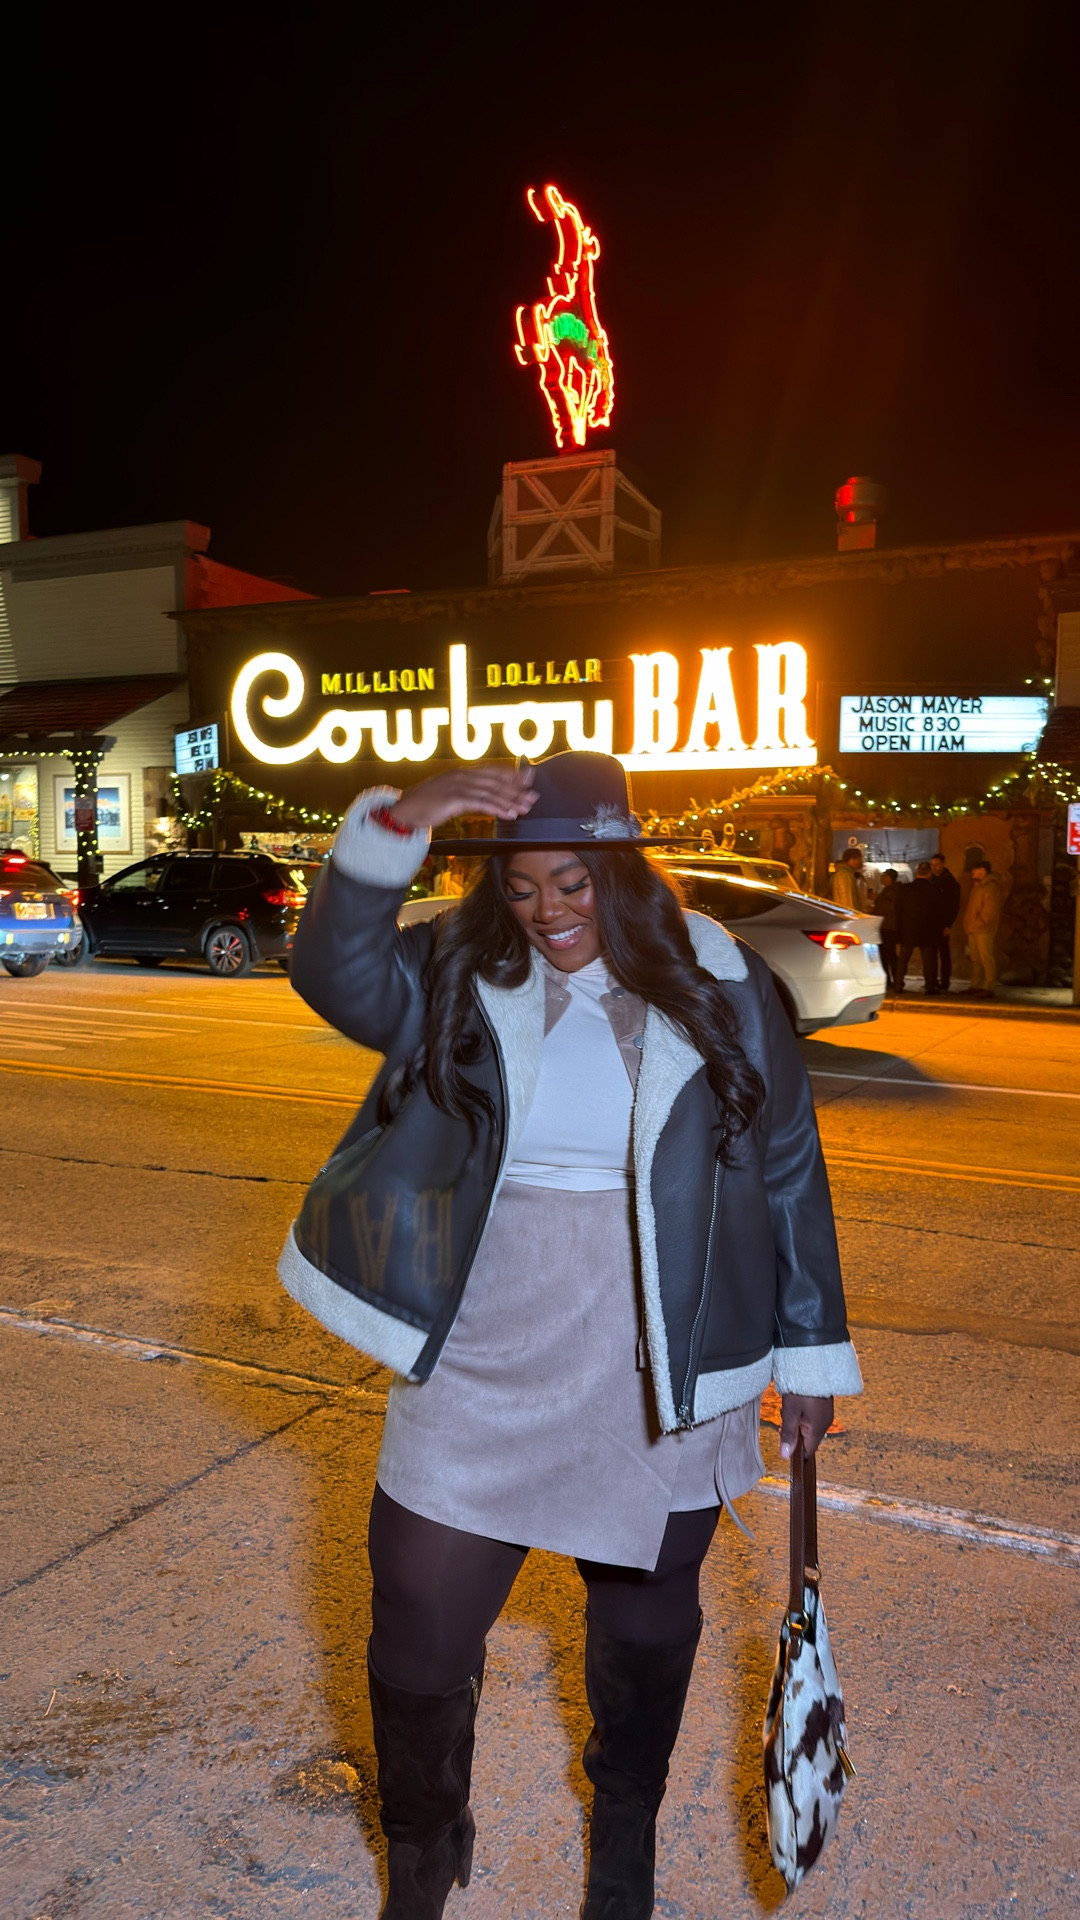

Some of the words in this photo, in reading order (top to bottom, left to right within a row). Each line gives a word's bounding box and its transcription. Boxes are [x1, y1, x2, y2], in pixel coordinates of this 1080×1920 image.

[321, 667, 435, 695] MILLION
[486, 658, 602, 687] DOLLAR
[231, 644, 613, 764] Cowboy
[627, 641, 816, 755] BAR
[851, 697, 911, 713] JASON
[922, 697, 982, 714] MAYER
[859, 716, 915, 732] MUSIC
[923, 716, 960, 732] 830
[861, 735, 910, 751] OPEN
[921, 735, 965, 751] 11AM
